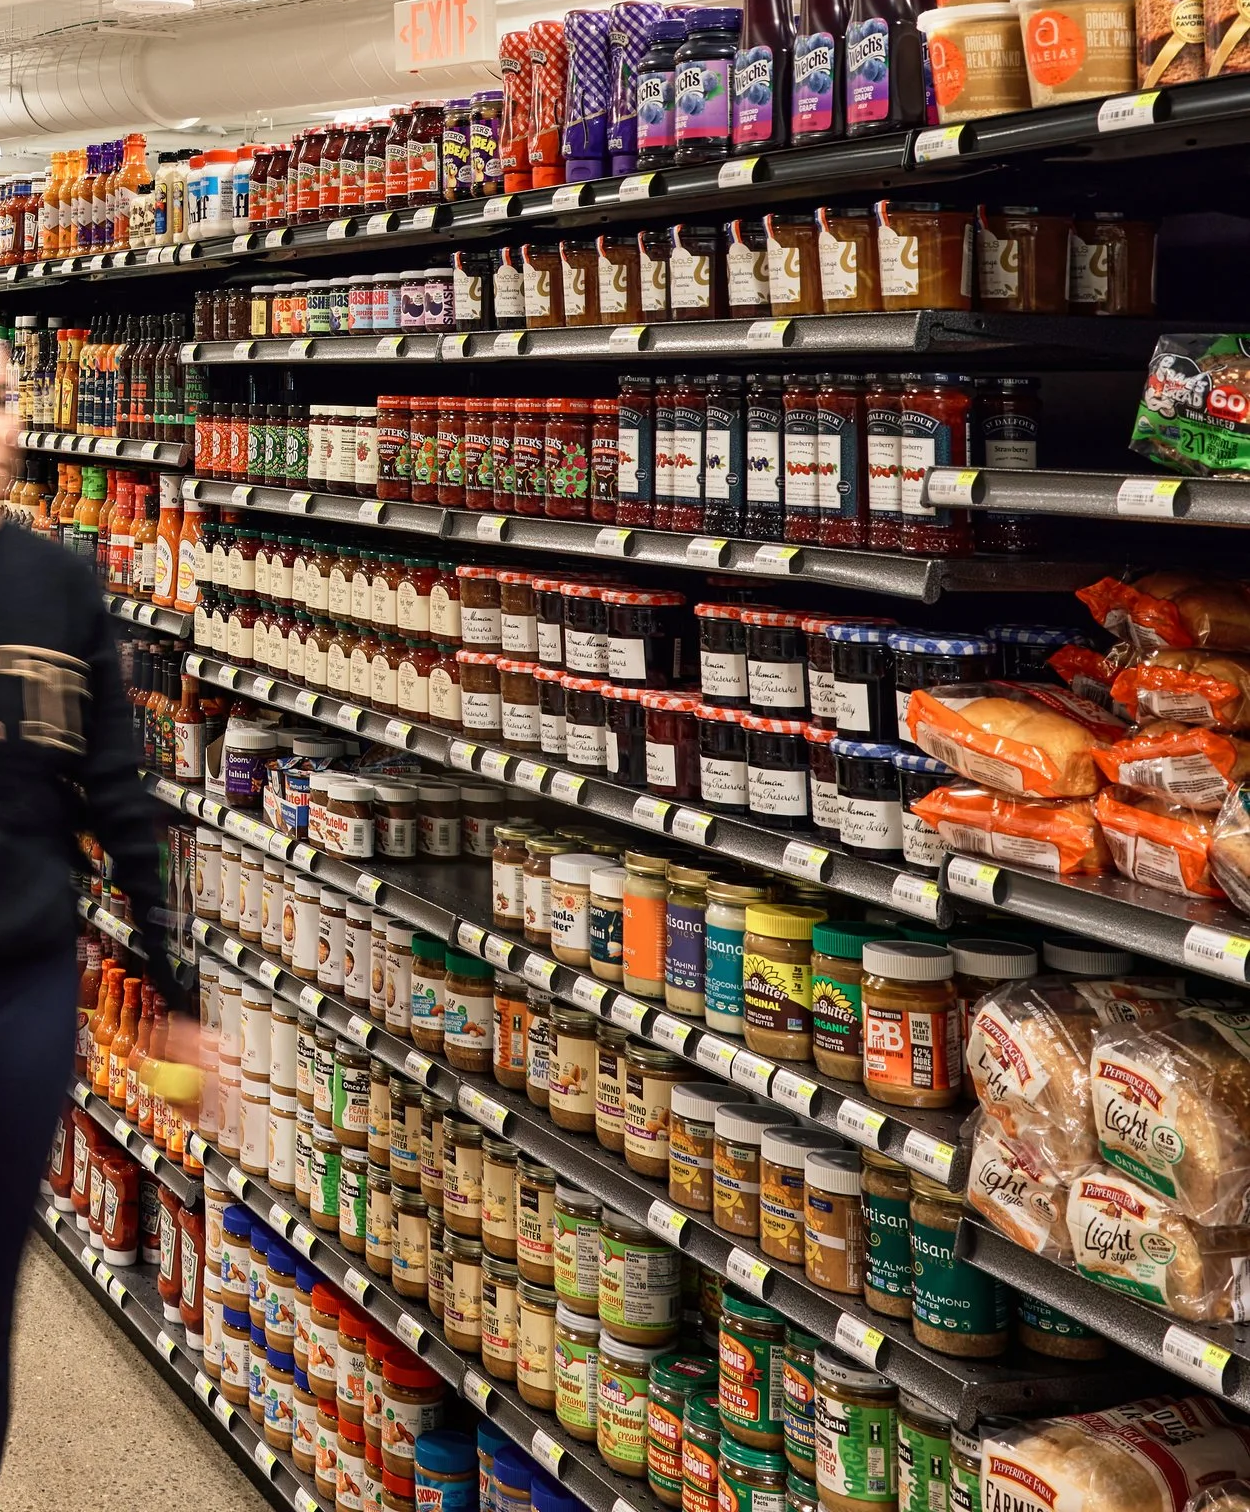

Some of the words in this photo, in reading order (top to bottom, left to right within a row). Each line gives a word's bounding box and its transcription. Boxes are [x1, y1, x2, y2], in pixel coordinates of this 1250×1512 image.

[1085, 12, 1127, 30] ORIGINAL
[964, 34, 1003, 51] ORIGINAL
[1087, 30, 1111, 47] REAL
[849, 36, 882, 67] Welch's
[966, 52, 987, 68] REAL
[990, 50, 1020, 67] PANKO
[795, 50, 828, 77] Welch's
[735, 62, 767, 91] Welch's
[854, 86, 874, 96] CONCORD
[854, 92, 872, 102] GRAPE
[798, 98, 819, 106] CONCORD
[799, 103, 817, 112] GRAPE
[739, 109, 759, 117] CONCORD
[740, 114, 757, 123] GRAPE
[444, 143, 470, 161] OBER
[471, 138, 497, 156] OBER
[443, 283, 454, 324] SMASH
[1210, 389, 1246, 413] 60
[994, 415, 1036, 432] DALFOUR
[1185, 409, 1236, 431] THIN-SLICED
[1181, 428, 1205, 454] 21
[994, 445, 1029, 455] Strawberry
[518, 453, 539, 464] Raspberry
[760, 681, 797, 694] Preserves
[229, 754, 250, 764] Soom
[229, 769, 250, 779] tahini
[710, 778, 746, 792] Preserves
[761, 788, 800, 802] Preserves
[326, 815, 348, 832] utella
[867, 819, 888, 834] Jelly
[909, 836, 934, 851] Grape
[673, 958, 697, 971] TAHINI
[744, 995, 781, 1012] ORIGINAL
[747, 1009, 773, 1022] SUNFLOWER
[881, 1011, 902, 1021] PROTEIN
[756, 1019, 775, 1028] BUTTER
[814, 1016, 850, 1035] ORGANIC
[911, 1020, 930, 1030] 100%
[912, 1026, 929, 1035] PLANT
[500, 1000, 511, 1067] NATURAL
[528, 1030, 541, 1040] Once
[816, 1033, 843, 1045] SUNFLOWER
[867, 1019, 904, 1052] PB
[871, 1034, 886, 1048] fit
[912, 1033, 929, 1041] BASED
[981, 1017, 1019, 1056] PEPPERIDGE
[826, 1042, 845, 1052] BUTTER
[913, 1047, 932, 1058] 42%
[913, 1056, 932, 1065] MORE
[597, 1081, 620, 1095] ALMOND
[1103, 1065, 1146, 1093] PEPPERIDGE
[1144, 1084, 1160, 1107] FARM
[597, 1092, 619, 1104] BUTTER
[1105, 1098, 1149, 1142] Light
[1129, 1136, 1148, 1152] style
[1156, 1131, 1174, 1146] 45
[731, 1149, 749, 1158] CREAMY
[1115, 1155, 1157, 1185] OATMEAL
[979, 1159, 1028, 1202] Light
[763, 1192, 785, 1205] NATURAL
[998, 1191, 1024, 1208] style
[1085, 1183, 1125, 1205] PEPPERIDGE
[1122, 1192, 1140, 1212] FARM
[519, 1217, 542, 1232] PEANUT
[763, 1217, 786, 1230] ALMOND
[519, 1228, 542, 1241] BUTTER
[1085, 1216, 1135, 1261] Light
[1148, 1236, 1167, 1247] 45
[626, 1251, 647, 1259] Nutrition
[866, 1254, 881, 1267] RAW
[1111, 1250, 1138, 1265] style
[872, 1267, 898, 1279] BUTTER
[1097, 1274, 1145, 1297] OATMEAL
[601, 1292, 624, 1310] creamy
[916, 1297, 940, 1311] BUTTER
[925, 1291, 971, 1309] ALMOND
[1024, 1303, 1051, 1315] BUTTER
[615, 1403, 642, 1418] Natural
[729, 1402, 755, 1419] Butter
[612, 1412, 645, 1431] Butter
[820, 1411, 848, 1432] Again
[617, 1431, 648, 1449] creamy
[843, 1403, 863, 1495] ORGANIC
[993, 1458, 1032, 1486] PEPPERIDGE
[1032, 1479, 1052, 1500] FARM
[417, 1488, 442, 1504] SKIPPY
[753, 1492, 777, 1502] Nutrition
[753, 1499, 769, 1508] Facts
